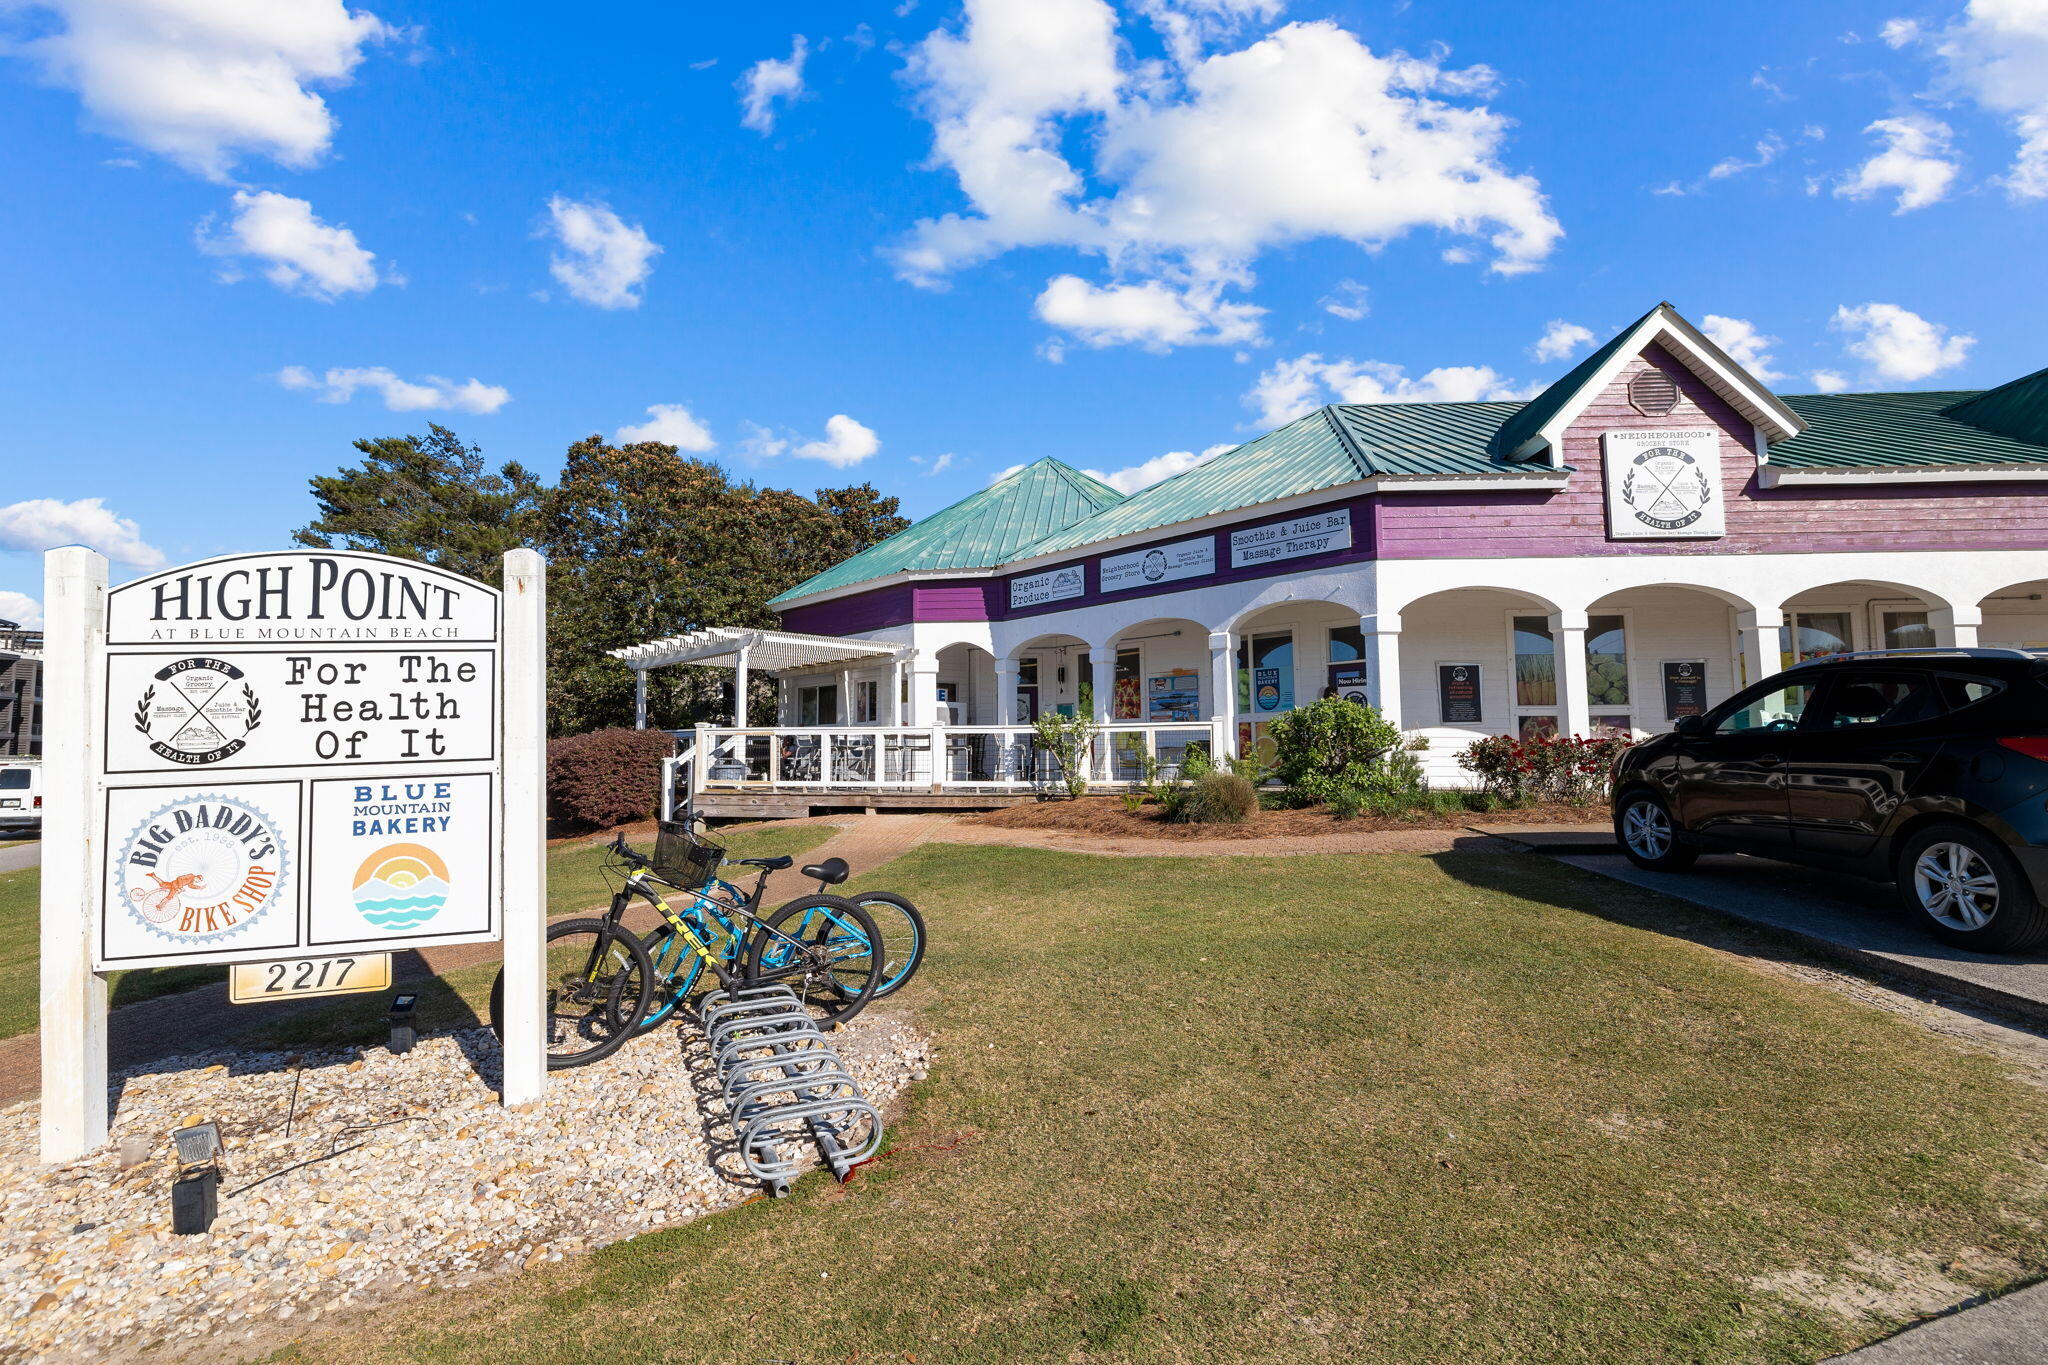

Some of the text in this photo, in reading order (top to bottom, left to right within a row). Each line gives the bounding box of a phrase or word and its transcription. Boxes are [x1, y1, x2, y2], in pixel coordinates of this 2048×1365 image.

[1641, 448, 1686, 460] FOR THE
[1233, 515, 1346, 546] Smoothie & Juice Bar
[1639, 512, 1698, 528] HEALTH OF IT
[1243, 537, 1330, 560] Massage Therapy
[1102, 561, 1140, 574] Neighborhood
[1102, 573, 1123, 582] Grocery
[1124, 570, 1140, 578] Store
[150, 558, 460, 621] HIGH POINT
[1012, 576, 1050, 592] Organic
[1012, 591, 1050, 605] Produce
[151, 627, 458, 639] AT BLUE MOUNTAIN BEACH
[168, 659, 232, 674] FOR THE
[285, 655, 476, 685] For The
[300, 691, 460, 722] Health
[155, 743, 200, 763] HEALTH
[207, 752, 222, 761] OF
[226, 741, 240, 754] IT
[315, 727, 446, 759] Of It
[353, 782, 451, 802] BLUE
[353, 802, 451, 816] MOUNTAIN
[129, 804, 275, 868] BIG DADDY'S
[352, 815, 451, 836] BAKERY
[178, 865, 276, 932] BIKE SHOP
[655, 895, 718, 967] TREK
[264, 958, 356, 992] 2217
